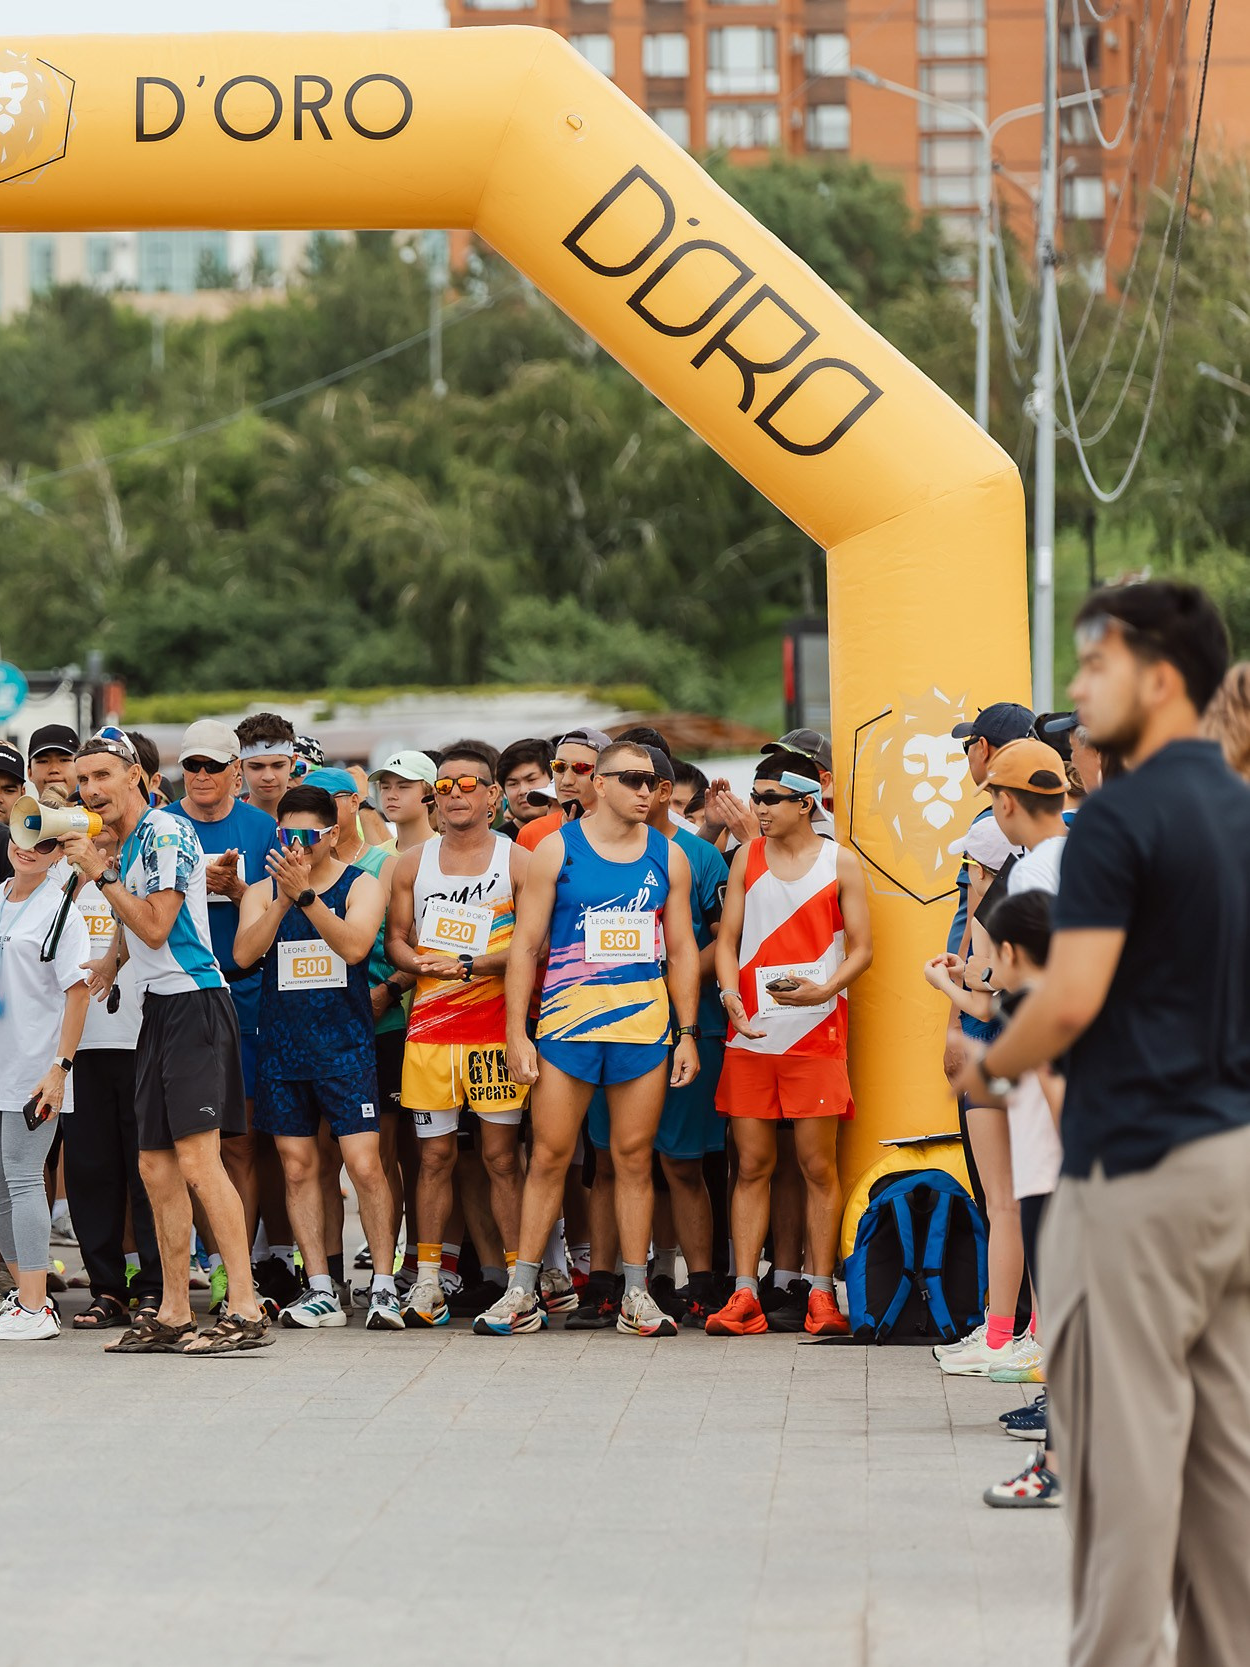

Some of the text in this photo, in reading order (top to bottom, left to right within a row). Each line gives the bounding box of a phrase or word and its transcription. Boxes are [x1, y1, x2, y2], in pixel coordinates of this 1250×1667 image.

[135, 73, 413, 142] D'ORO
[561, 164, 884, 457] D'ORO
[77, 904, 97, 912] EONE
[431, 904, 456, 916] LEONE
[86, 917, 117, 934] 192
[439, 920, 472, 941] 320
[604, 932, 637, 949] 360
[283, 946, 307, 954] LEONE
[296, 958, 328, 976] 500
[469, 1084, 517, 1101] SPORTS
